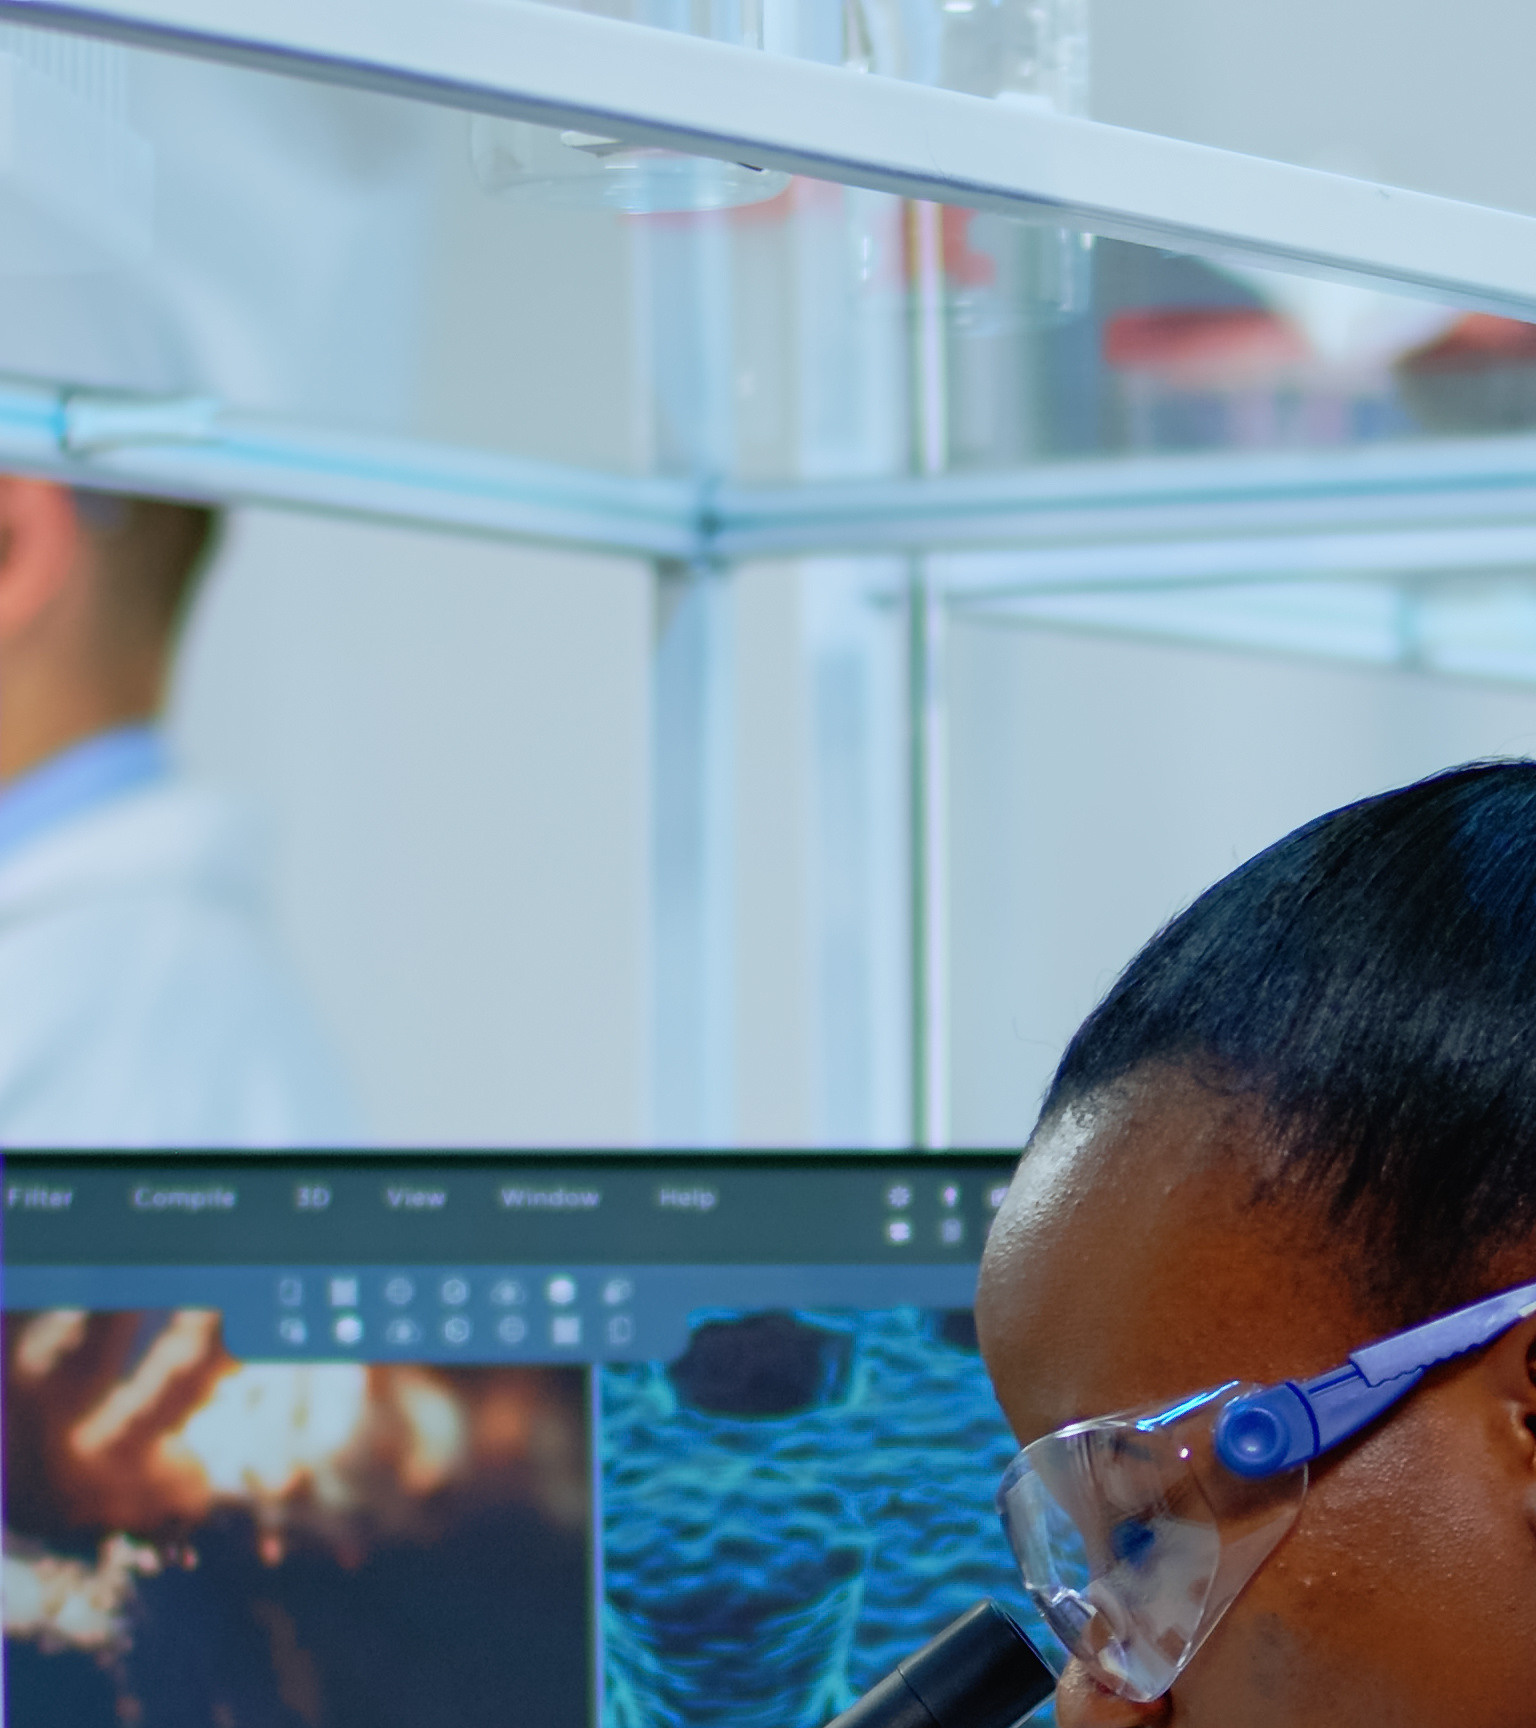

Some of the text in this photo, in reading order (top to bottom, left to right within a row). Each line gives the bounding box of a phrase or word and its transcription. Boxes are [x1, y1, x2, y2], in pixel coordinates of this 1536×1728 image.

[6, 1185, 75, 1209] Filter
[132, 1186, 236, 1213] Compile
[296, 1185, 331, 1208] 3D
[386, 1186, 447, 1208] View
[500, 1186, 602, 1208] Window
[659, 1186, 718, 1212] Help
